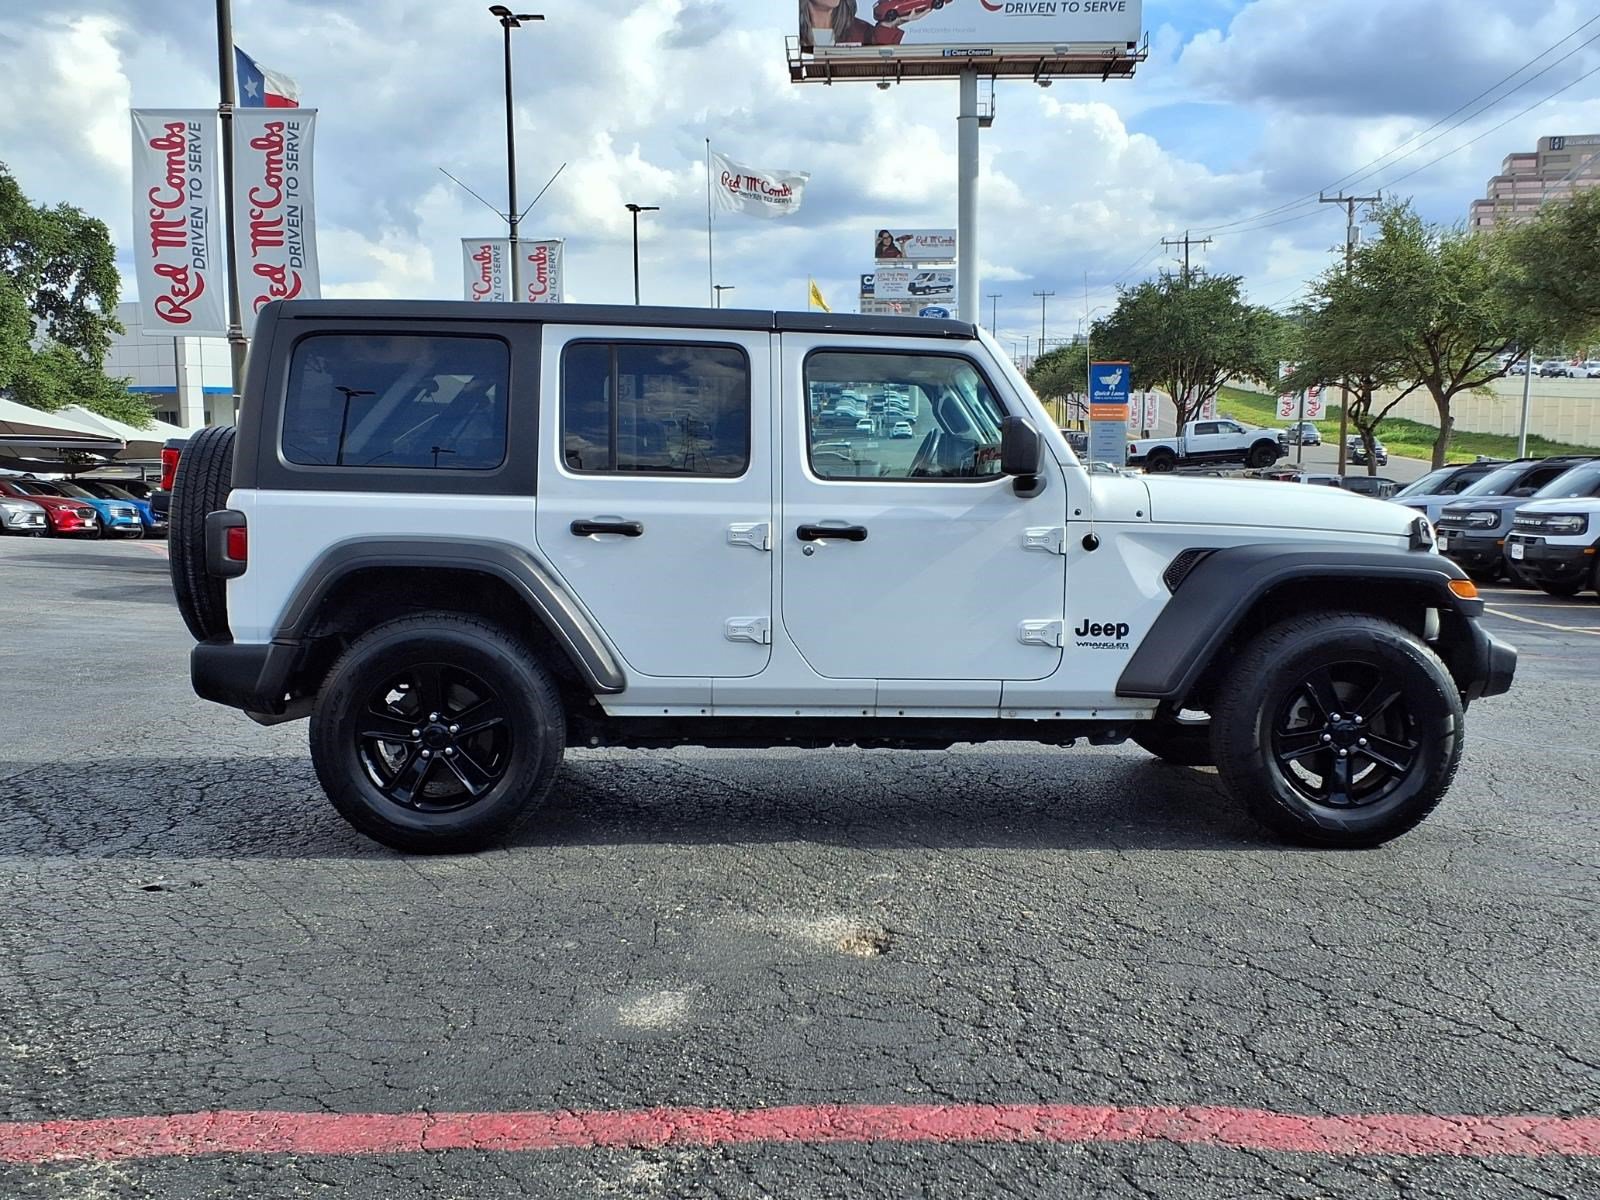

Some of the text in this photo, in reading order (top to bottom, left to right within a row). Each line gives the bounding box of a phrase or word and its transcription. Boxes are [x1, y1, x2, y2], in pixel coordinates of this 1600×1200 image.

[1005, 1, 1126, 14] DRIVEN TO SERVE
[189, 122, 204, 269] DRIVEN TO SERVE
[250, 122, 284, 257] McCombs
[286, 121, 303, 269] DRIVEN TO SERVE
[721, 170, 742, 193] Red
[150, 122, 205, 324] Red McCombs
[493, 244, 502, 274] SERVE
[548, 246, 557, 275] SERVE
[494, 277, 502, 289] TO
[549, 279, 557, 291] TO
[1075, 618, 1130, 640] Jeep
